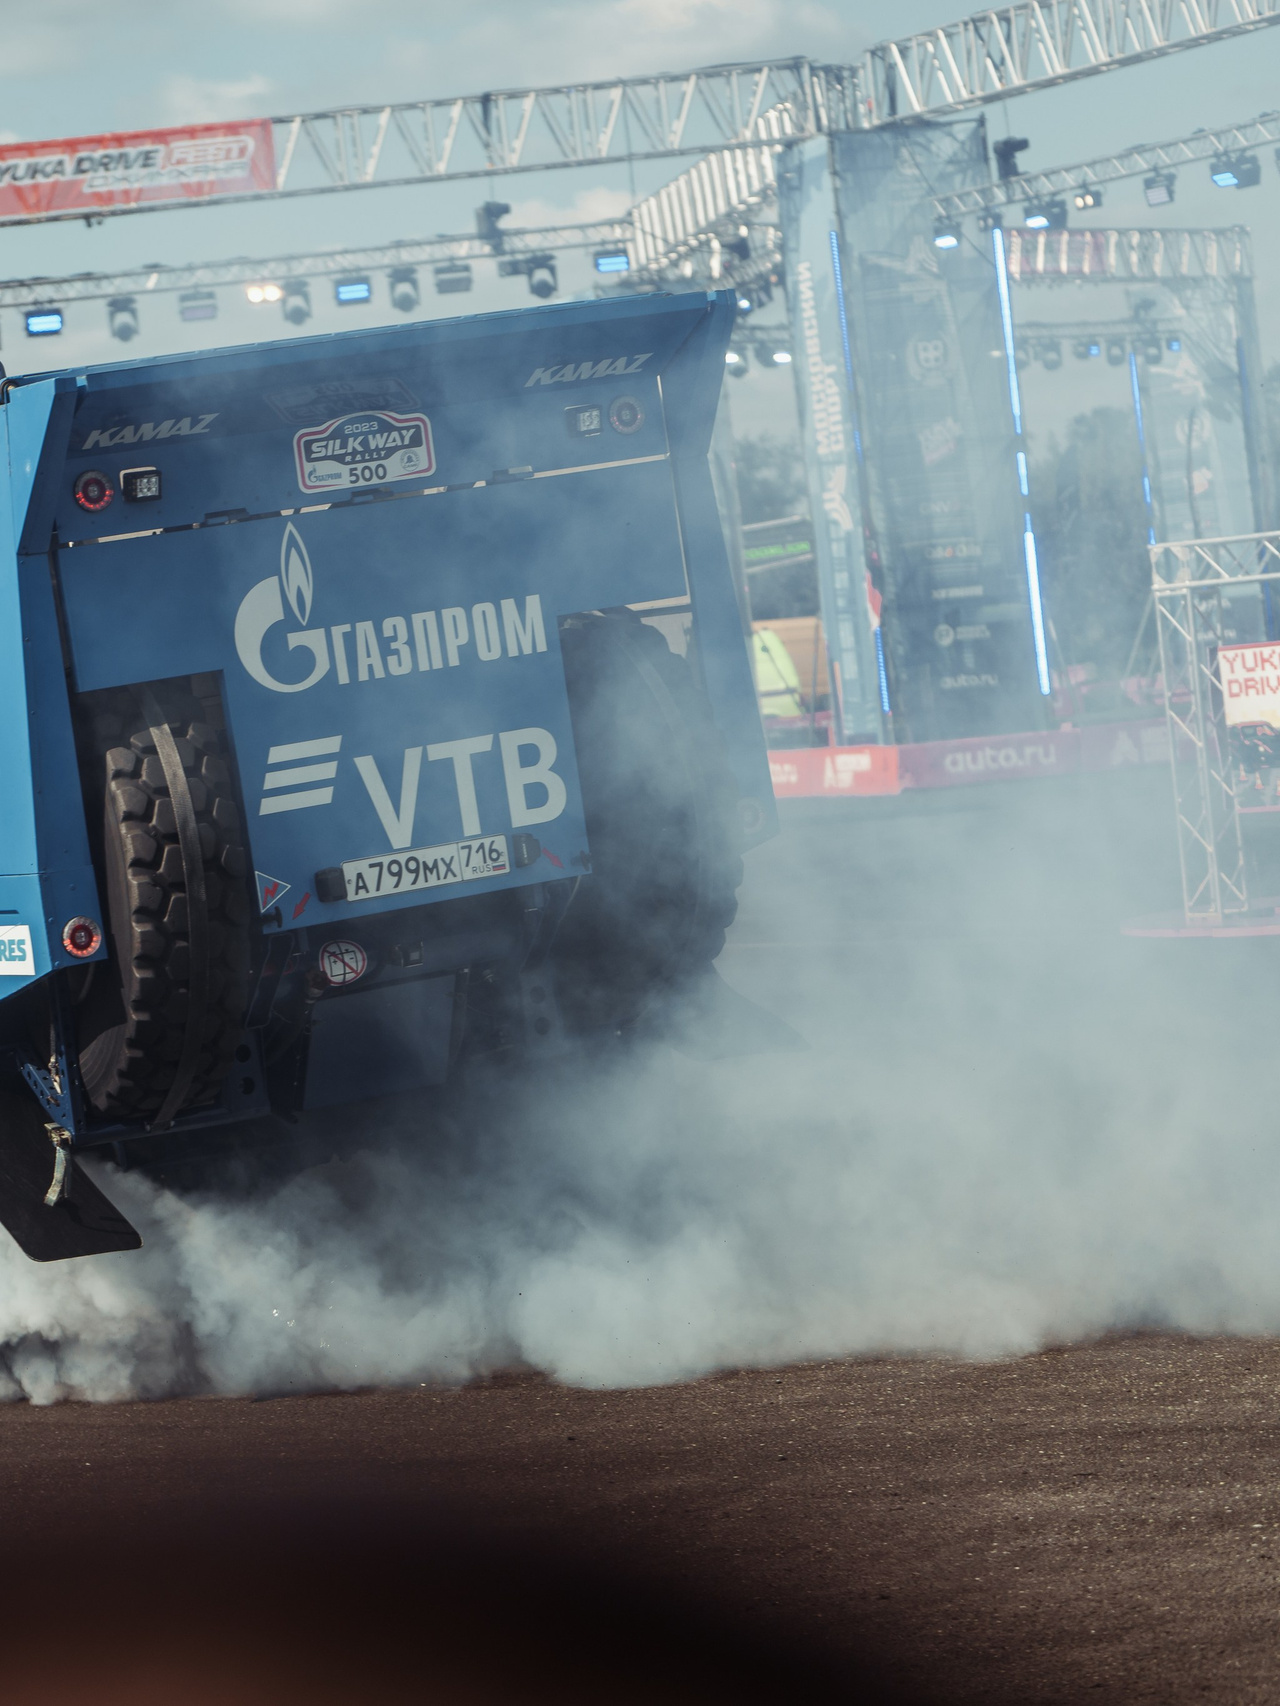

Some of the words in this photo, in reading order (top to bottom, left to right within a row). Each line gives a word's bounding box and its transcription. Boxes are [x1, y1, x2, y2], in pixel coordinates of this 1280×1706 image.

[72, 149, 160, 175] DRIVE
[524, 352, 655, 388] KAMAZ
[81, 412, 220, 450] KAMAZ
[343, 421, 379, 435] 2023
[310, 435, 365, 459] SILK
[367, 428, 417, 450] WAY
[344, 450, 387, 463] RALLY
[349, 463, 388, 485] 500
[331, 593, 549, 686] ГАЗПРОМ
[1222, 648, 1280, 674] YUK
[945, 741, 1056, 774] auto.ru
[353, 727, 568, 850] VTB
[460, 839, 501, 868] 716
[472, 863, 493, 875] RUS
